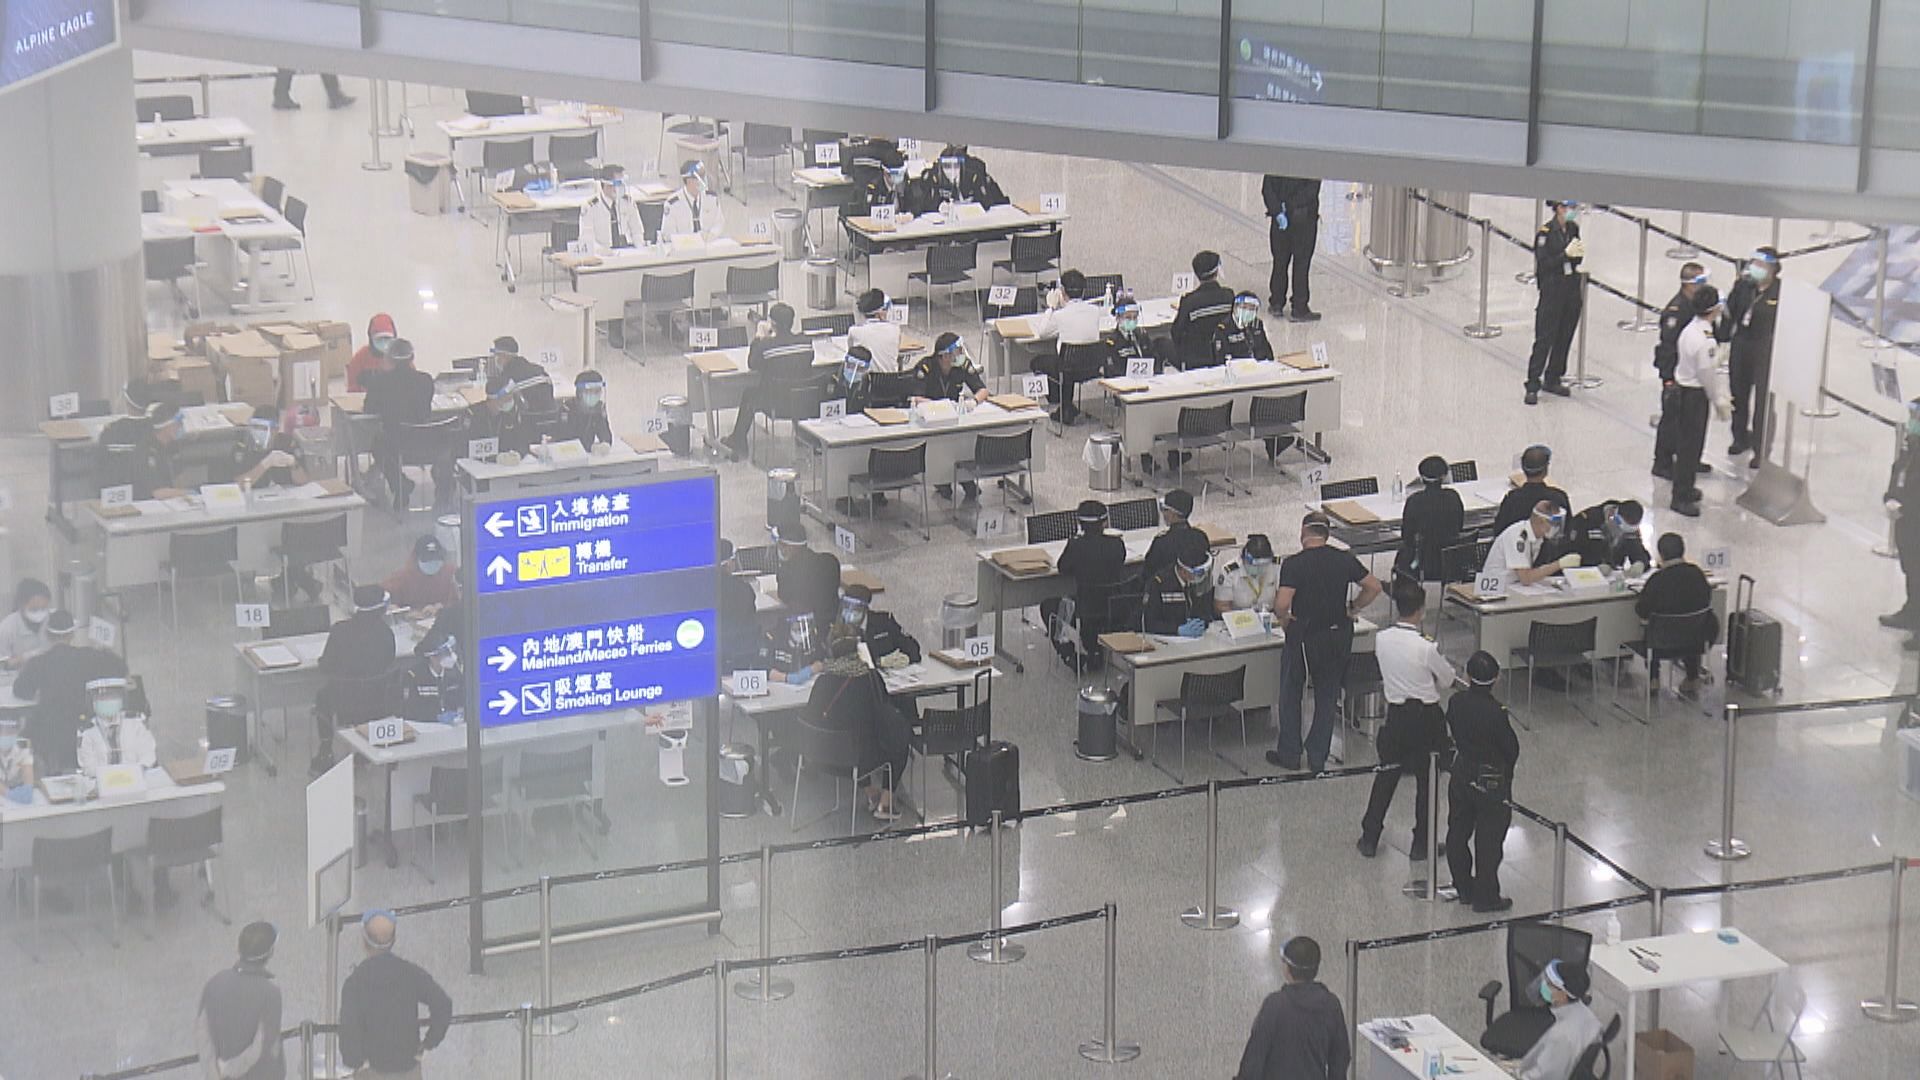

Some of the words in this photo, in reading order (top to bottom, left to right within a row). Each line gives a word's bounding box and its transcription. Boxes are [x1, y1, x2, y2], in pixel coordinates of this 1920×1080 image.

[15, 26, 55, 55] ALPINE
[59, 11, 95, 38] EAGLE
[903, 138, 917, 149] 48
[820, 147, 834, 159] 47
[1045, 196, 1059, 209] 41
[875, 208, 890, 220] 42
[753, 222, 767, 234] 43
[1176, 277, 1189, 290] 31
[994, 287, 1011, 300] 32
[695, 331, 711, 344] 34
[1132, 361, 1149, 374] 22
[1028, 379, 1044, 394] 23
[825, 403, 840, 417] 24
[646, 417, 662, 433] 25
[474, 441, 492, 454] 26
[1307, 470, 1322, 485] 12
[551, 491, 631, 519] 入境檢查
[551, 512, 629, 534] Immigration
[985, 519, 997, 532] 14
[839, 533, 851, 549] 15
[575, 538, 612, 561] 轉機
[575, 556, 629, 575] Transfer
[1706, 552, 1724, 566] 01
[1480, 577, 1499, 592] 02
[245, 608, 262, 623] 18
[521, 647, 628, 672] Mainland/Macao
[631, 640, 673, 656] Ferries
[970, 641, 988, 657] 05
[555, 671, 613, 695] 吸煙室
[740, 675, 760, 691] 06
[555, 691, 612, 711] Smoking
[615, 685, 663, 704] Lounge
[376, 723, 396, 739] 08
